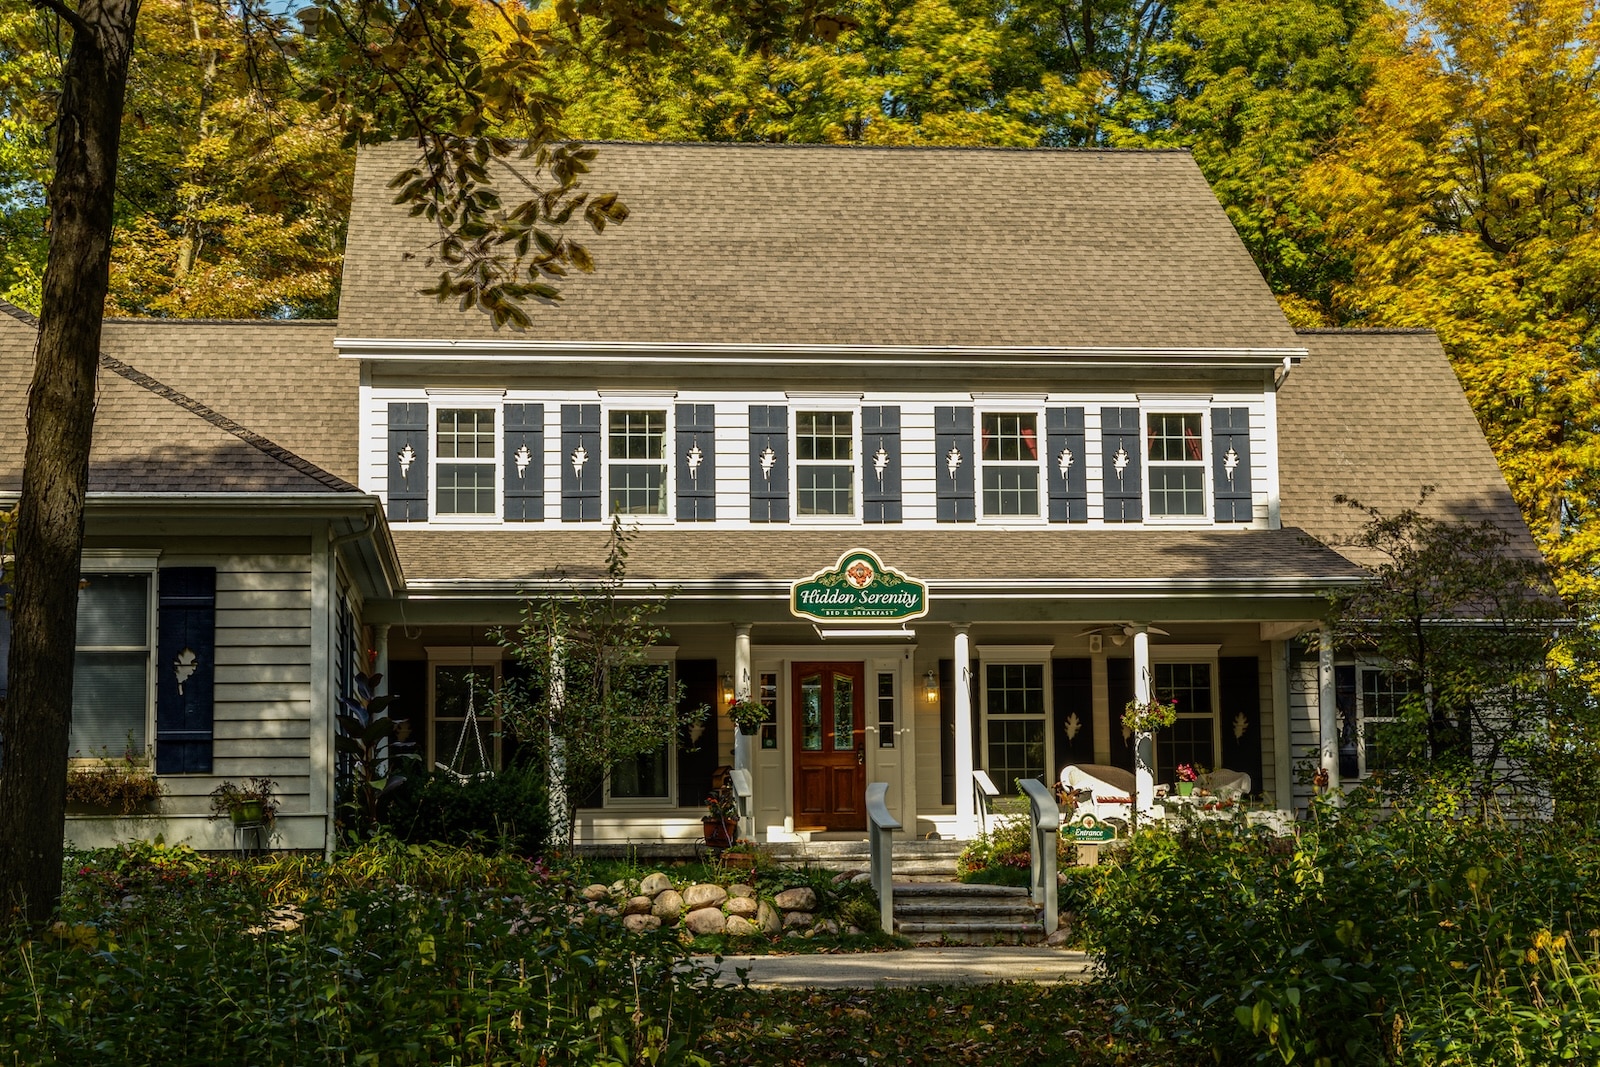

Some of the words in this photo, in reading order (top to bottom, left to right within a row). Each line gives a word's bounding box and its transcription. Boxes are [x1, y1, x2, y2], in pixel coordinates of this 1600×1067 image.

[800, 589, 857, 604] Hidden
[858, 589, 919, 608] Serenity
[1075, 828, 1103, 836] Entrance
